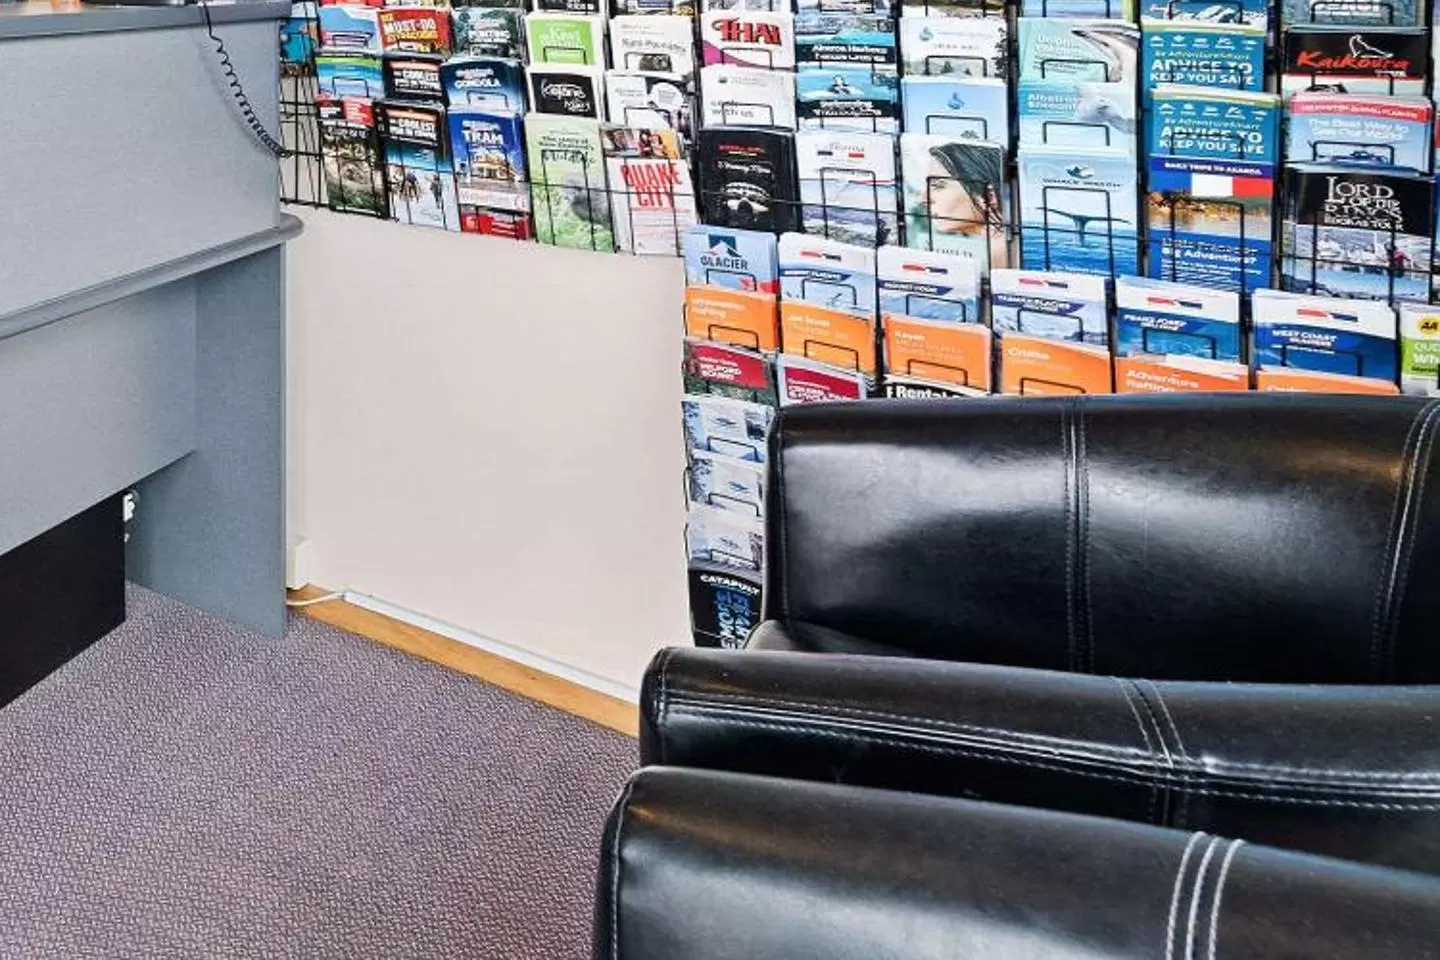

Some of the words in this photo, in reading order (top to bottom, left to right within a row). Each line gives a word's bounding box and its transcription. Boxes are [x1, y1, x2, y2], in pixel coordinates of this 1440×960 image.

[383, 19, 437, 33] MUST-DO
[712, 15, 782, 47] THAI
[1151, 59, 1223, 74] ADVICE
[1227, 60, 1254, 75] TO
[1297, 50, 1410, 70] Kaikoura
[454, 76, 502, 88] GONDOLA
[1149, 71, 1185, 83] KEEP
[1187, 72, 1217, 85] YOU
[462, 129, 504, 146] TRAM
[1161, 126, 1233, 142] ADVICE
[1236, 131, 1264, 144] TO
[1161, 139, 1195, 150] KEEP
[1197, 140, 1227, 152] YOU
[1229, 142, 1266, 156] SAFE
[620, 163, 683, 187] QUAKE
[635, 183, 674, 209] CITY
[1325, 176, 1395, 203] LORD
[1348, 197, 1372, 208] OF
[1375, 198, 1401, 210] THE
[1324, 203, 1403, 223] RINGS
[699, 255, 749, 271] GLACIER
[1272, 329, 1300, 338] WEST
[1301, 331, 1338, 343] COAST
[1127, 370, 1199, 389] Adventure
[896, 386, 960, 398] Rental
[700, 574, 760, 595] CATAPULT
